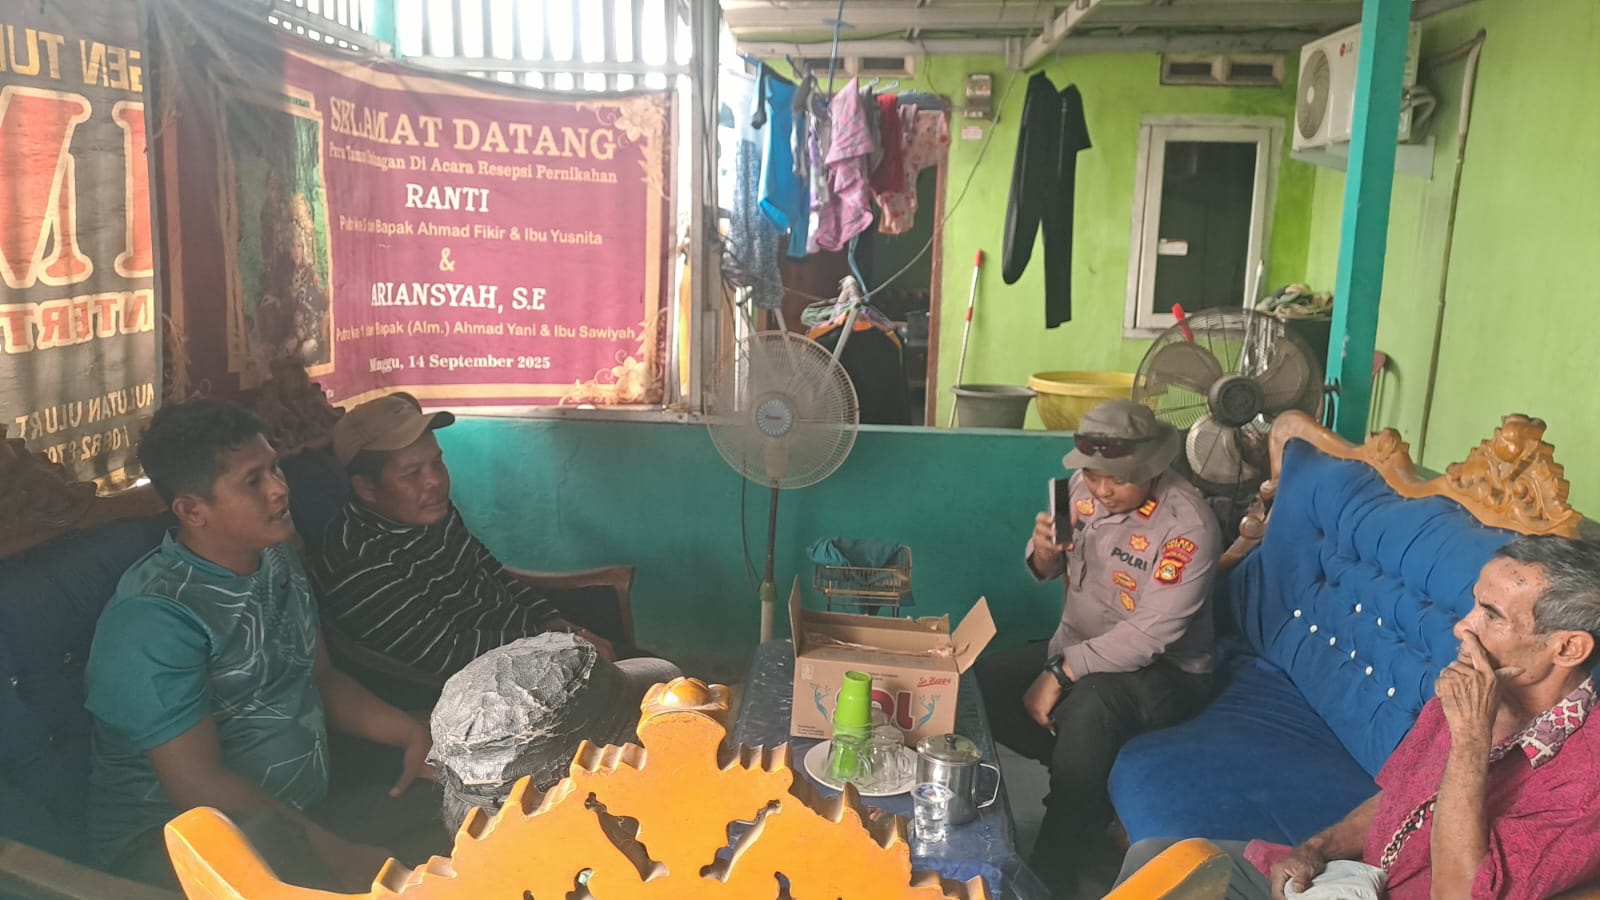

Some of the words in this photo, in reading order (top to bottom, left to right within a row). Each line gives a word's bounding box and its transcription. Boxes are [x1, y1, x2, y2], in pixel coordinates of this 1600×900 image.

[330, 96, 443, 148] SELAMAT
[453, 118, 617, 160] DATANG
[410, 155, 427, 171] Di
[431, 158, 474, 174] Acara
[478, 161, 533, 181] Resepsi
[536, 164, 618, 184] Pernikahan
[405, 183, 491, 213] RANTI
[376, 218, 414, 237] Bapak
[417, 221, 471, 239] Ahmad
[474, 224, 507, 239] Fikir
[510, 227, 521, 241] &
[524, 226, 547, 242] Ibu
[550, 229, 603, 246] Yusnita
[439, 247, 455, 272] &
[371, 282, 504, 314] ARIANSYAH,
[512, 287, 547, 311] S.E
[376, 321, 404, 338] Bapak
[407, 320, 450, 338] (Alm.)
[453, 321, 504, 336] Ahmad
[506, 323, 536, 337] Yani
[540, 324, 551, 337] &
[554, 323, 576, 338] Ibu
[579, 325, 635, 342] Sawiyah
[409, 354, 426, 368] 14
[429, 353, 514, 372] September
[517, 355, 551, 369] 2025
[1111, 547, 1148, 572] POLRI
